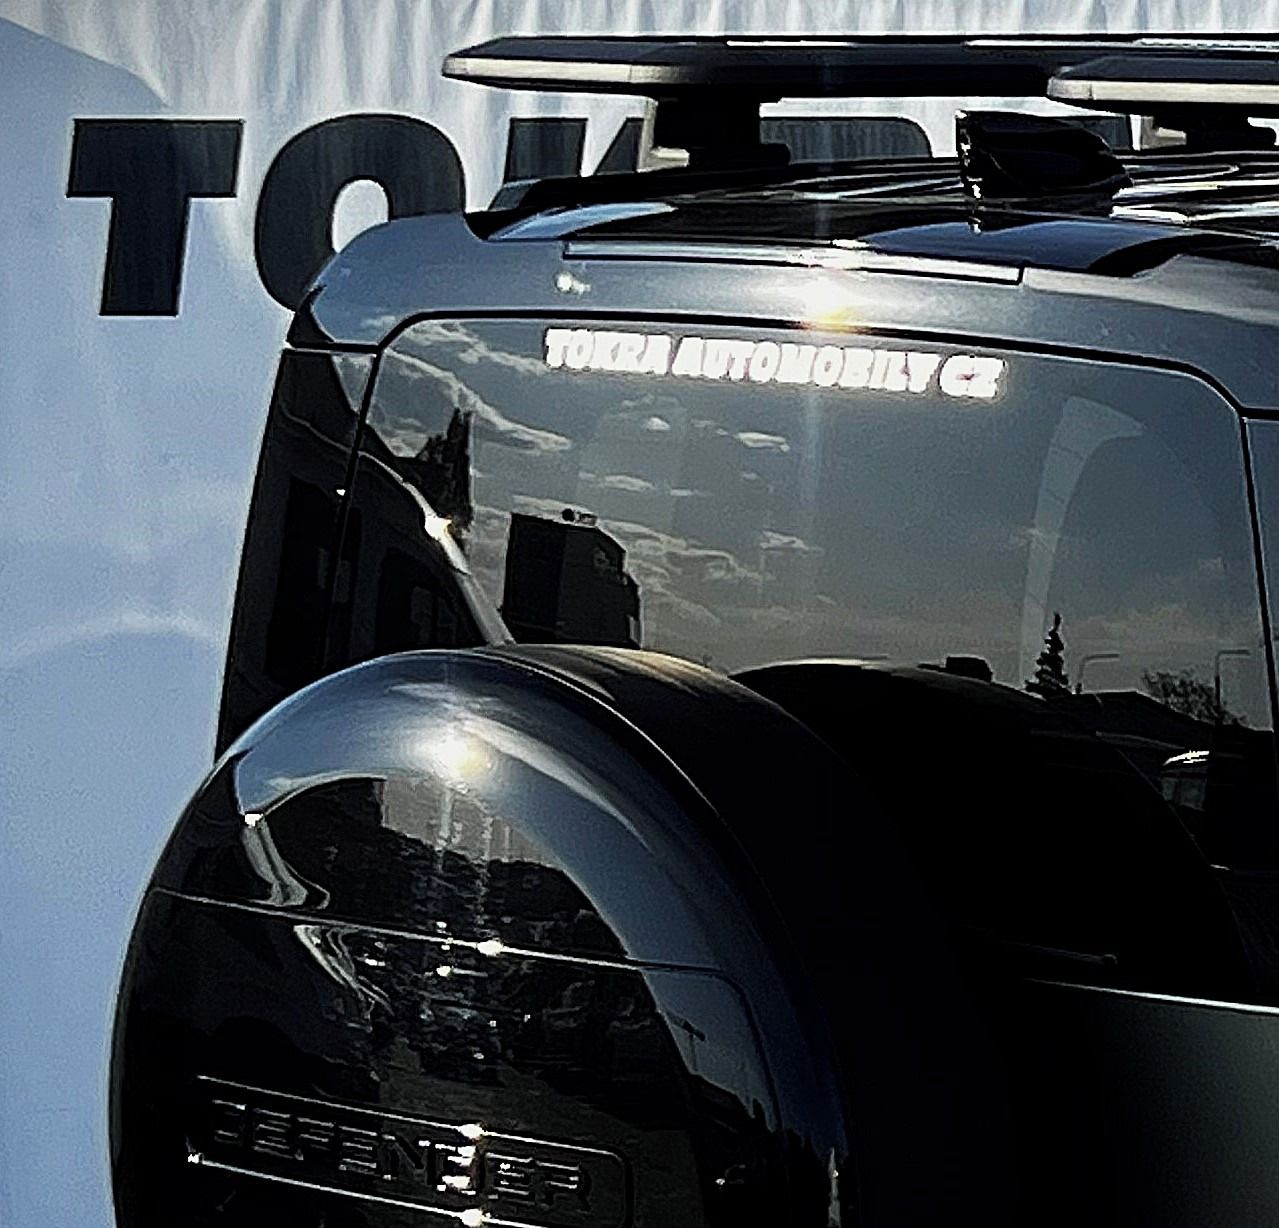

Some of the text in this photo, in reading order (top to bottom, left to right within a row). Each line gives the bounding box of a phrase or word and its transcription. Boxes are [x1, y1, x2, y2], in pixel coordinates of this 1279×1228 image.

[544, 327, 1004, 397] TOKRA AUTOMOBILY CZ
[212, 1099, 591, 1214] DEFENDER
